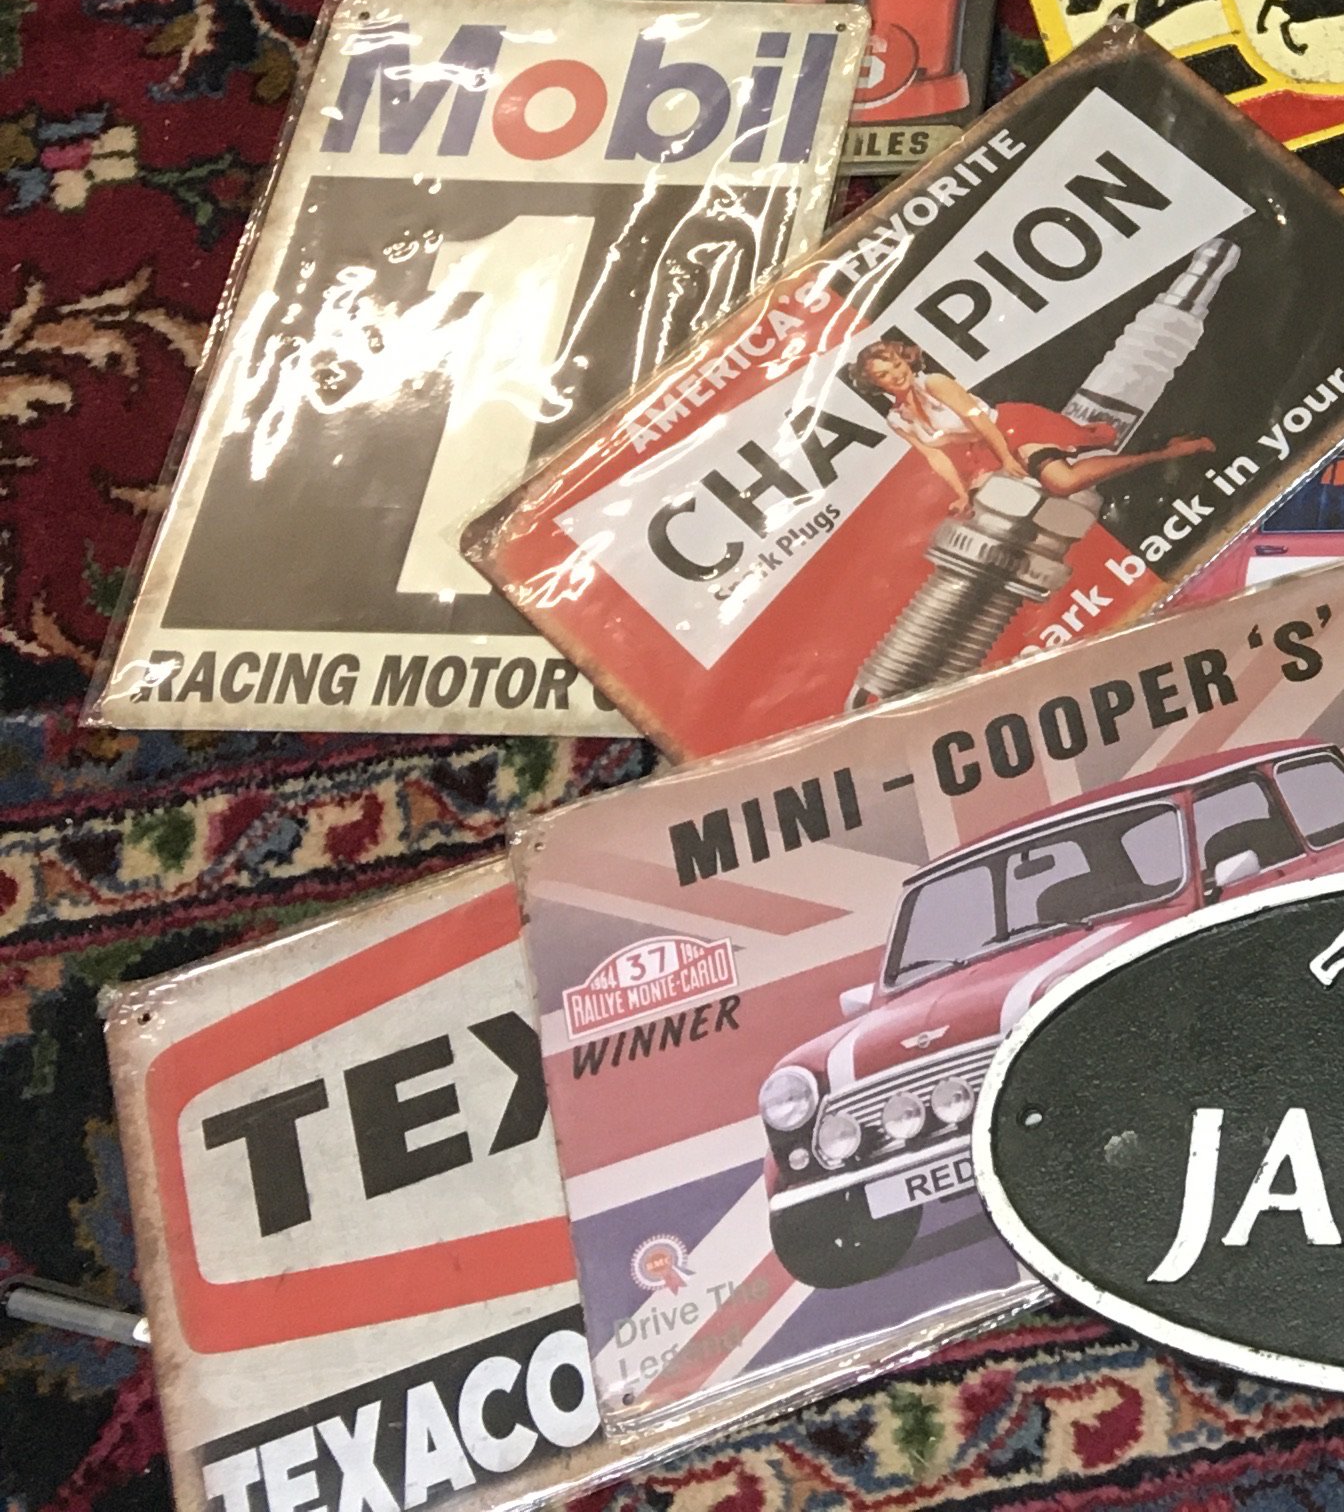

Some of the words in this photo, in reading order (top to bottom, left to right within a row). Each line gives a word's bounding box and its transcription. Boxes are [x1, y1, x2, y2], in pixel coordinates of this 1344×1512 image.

[320, 23, 843, 166] Mobil
[841, 131, 931, 157] ILES
[622, 276, 834, 455] AMERICA'S
[835, 128, 1028, 294] FAVORITE
[1104, 494, 1215, 586] back
[1205, 446, 1258, 500] in
[130, 650, 361, 710] RACING
[371, 652, 580, 712] MOTOR
[571, 990, 625, 1028] RALLYE
[627, 948, 730, 1011] MONTE-CARLO
[626, 945, 666, 982] 37
[573, 994, 741, 1080] WINNER
[905, 1157, 976, 1202] RED
[613, 1301, 700, 1350] Drive
[706, 1280, 770, 1310] The
[201, 1328, 602, 1512] TEXACO
